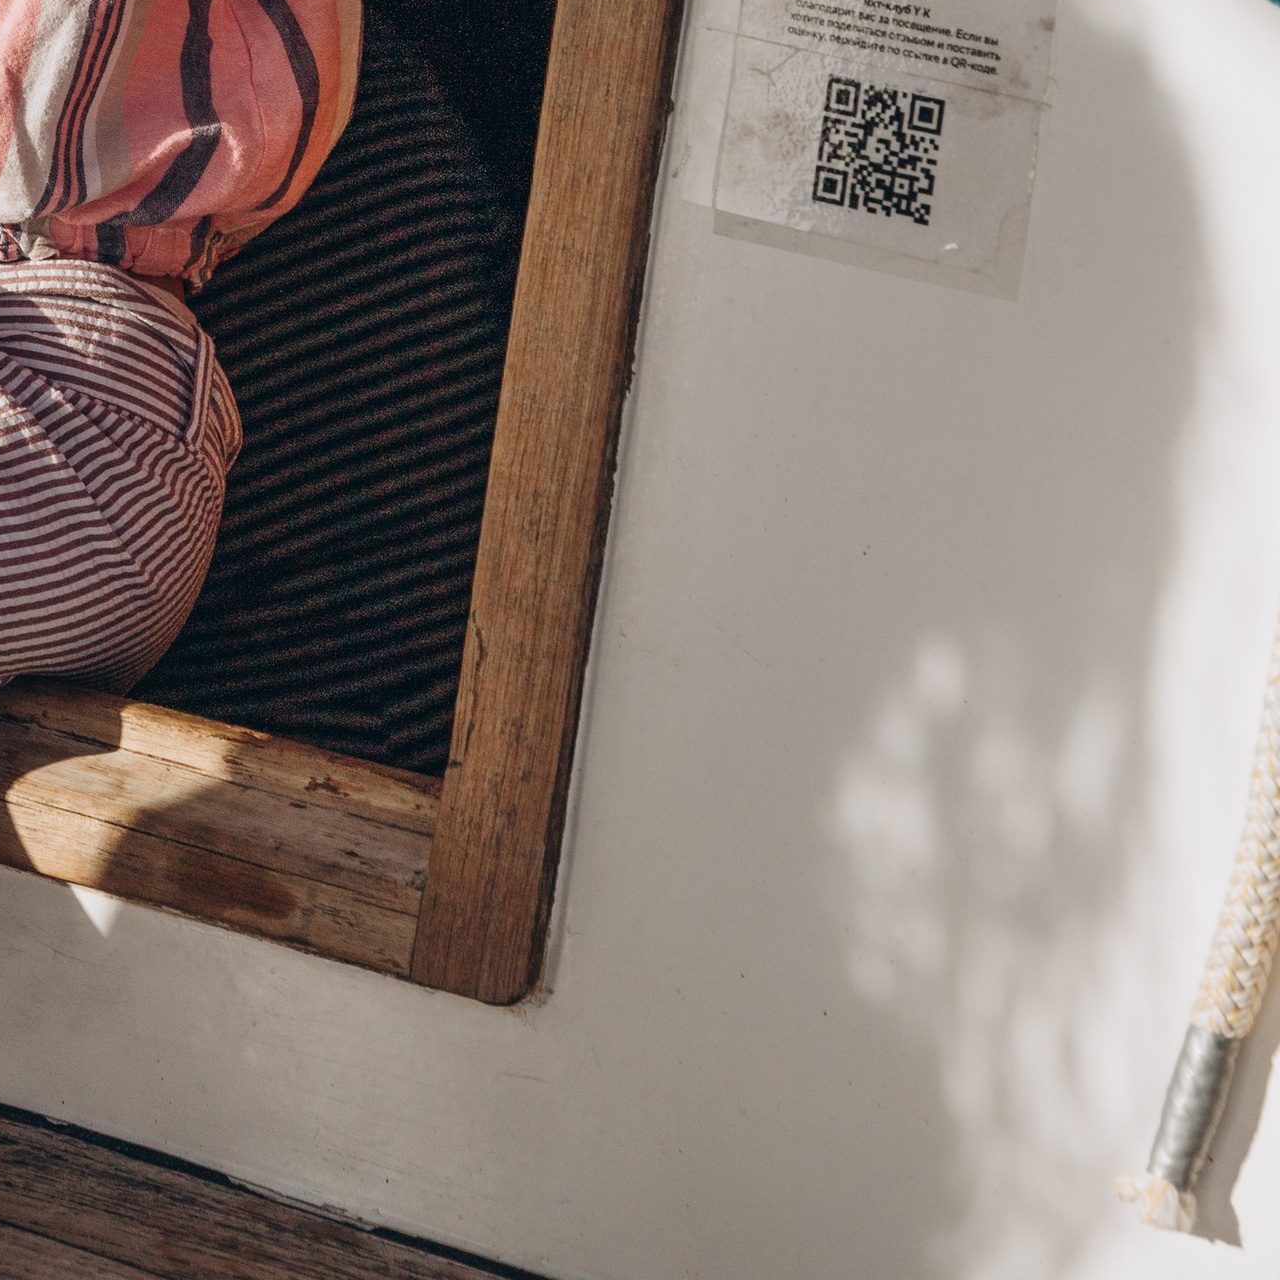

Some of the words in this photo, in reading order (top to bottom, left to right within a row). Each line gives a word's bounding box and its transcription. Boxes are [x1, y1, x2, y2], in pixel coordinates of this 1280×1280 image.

[790, 12, 825, 26] хотите
[827, 19, 887, 38] поделиться
[937, 41, 945, 50] и
[947, 43, 1002, 61] поставить
[858, 12, 876, 22] вас
[878, 15, 890, 24] за
[956, 29, 982, 42] Если
[984, 36, 999, 46] вы
[887, 45, 900, 55] по
